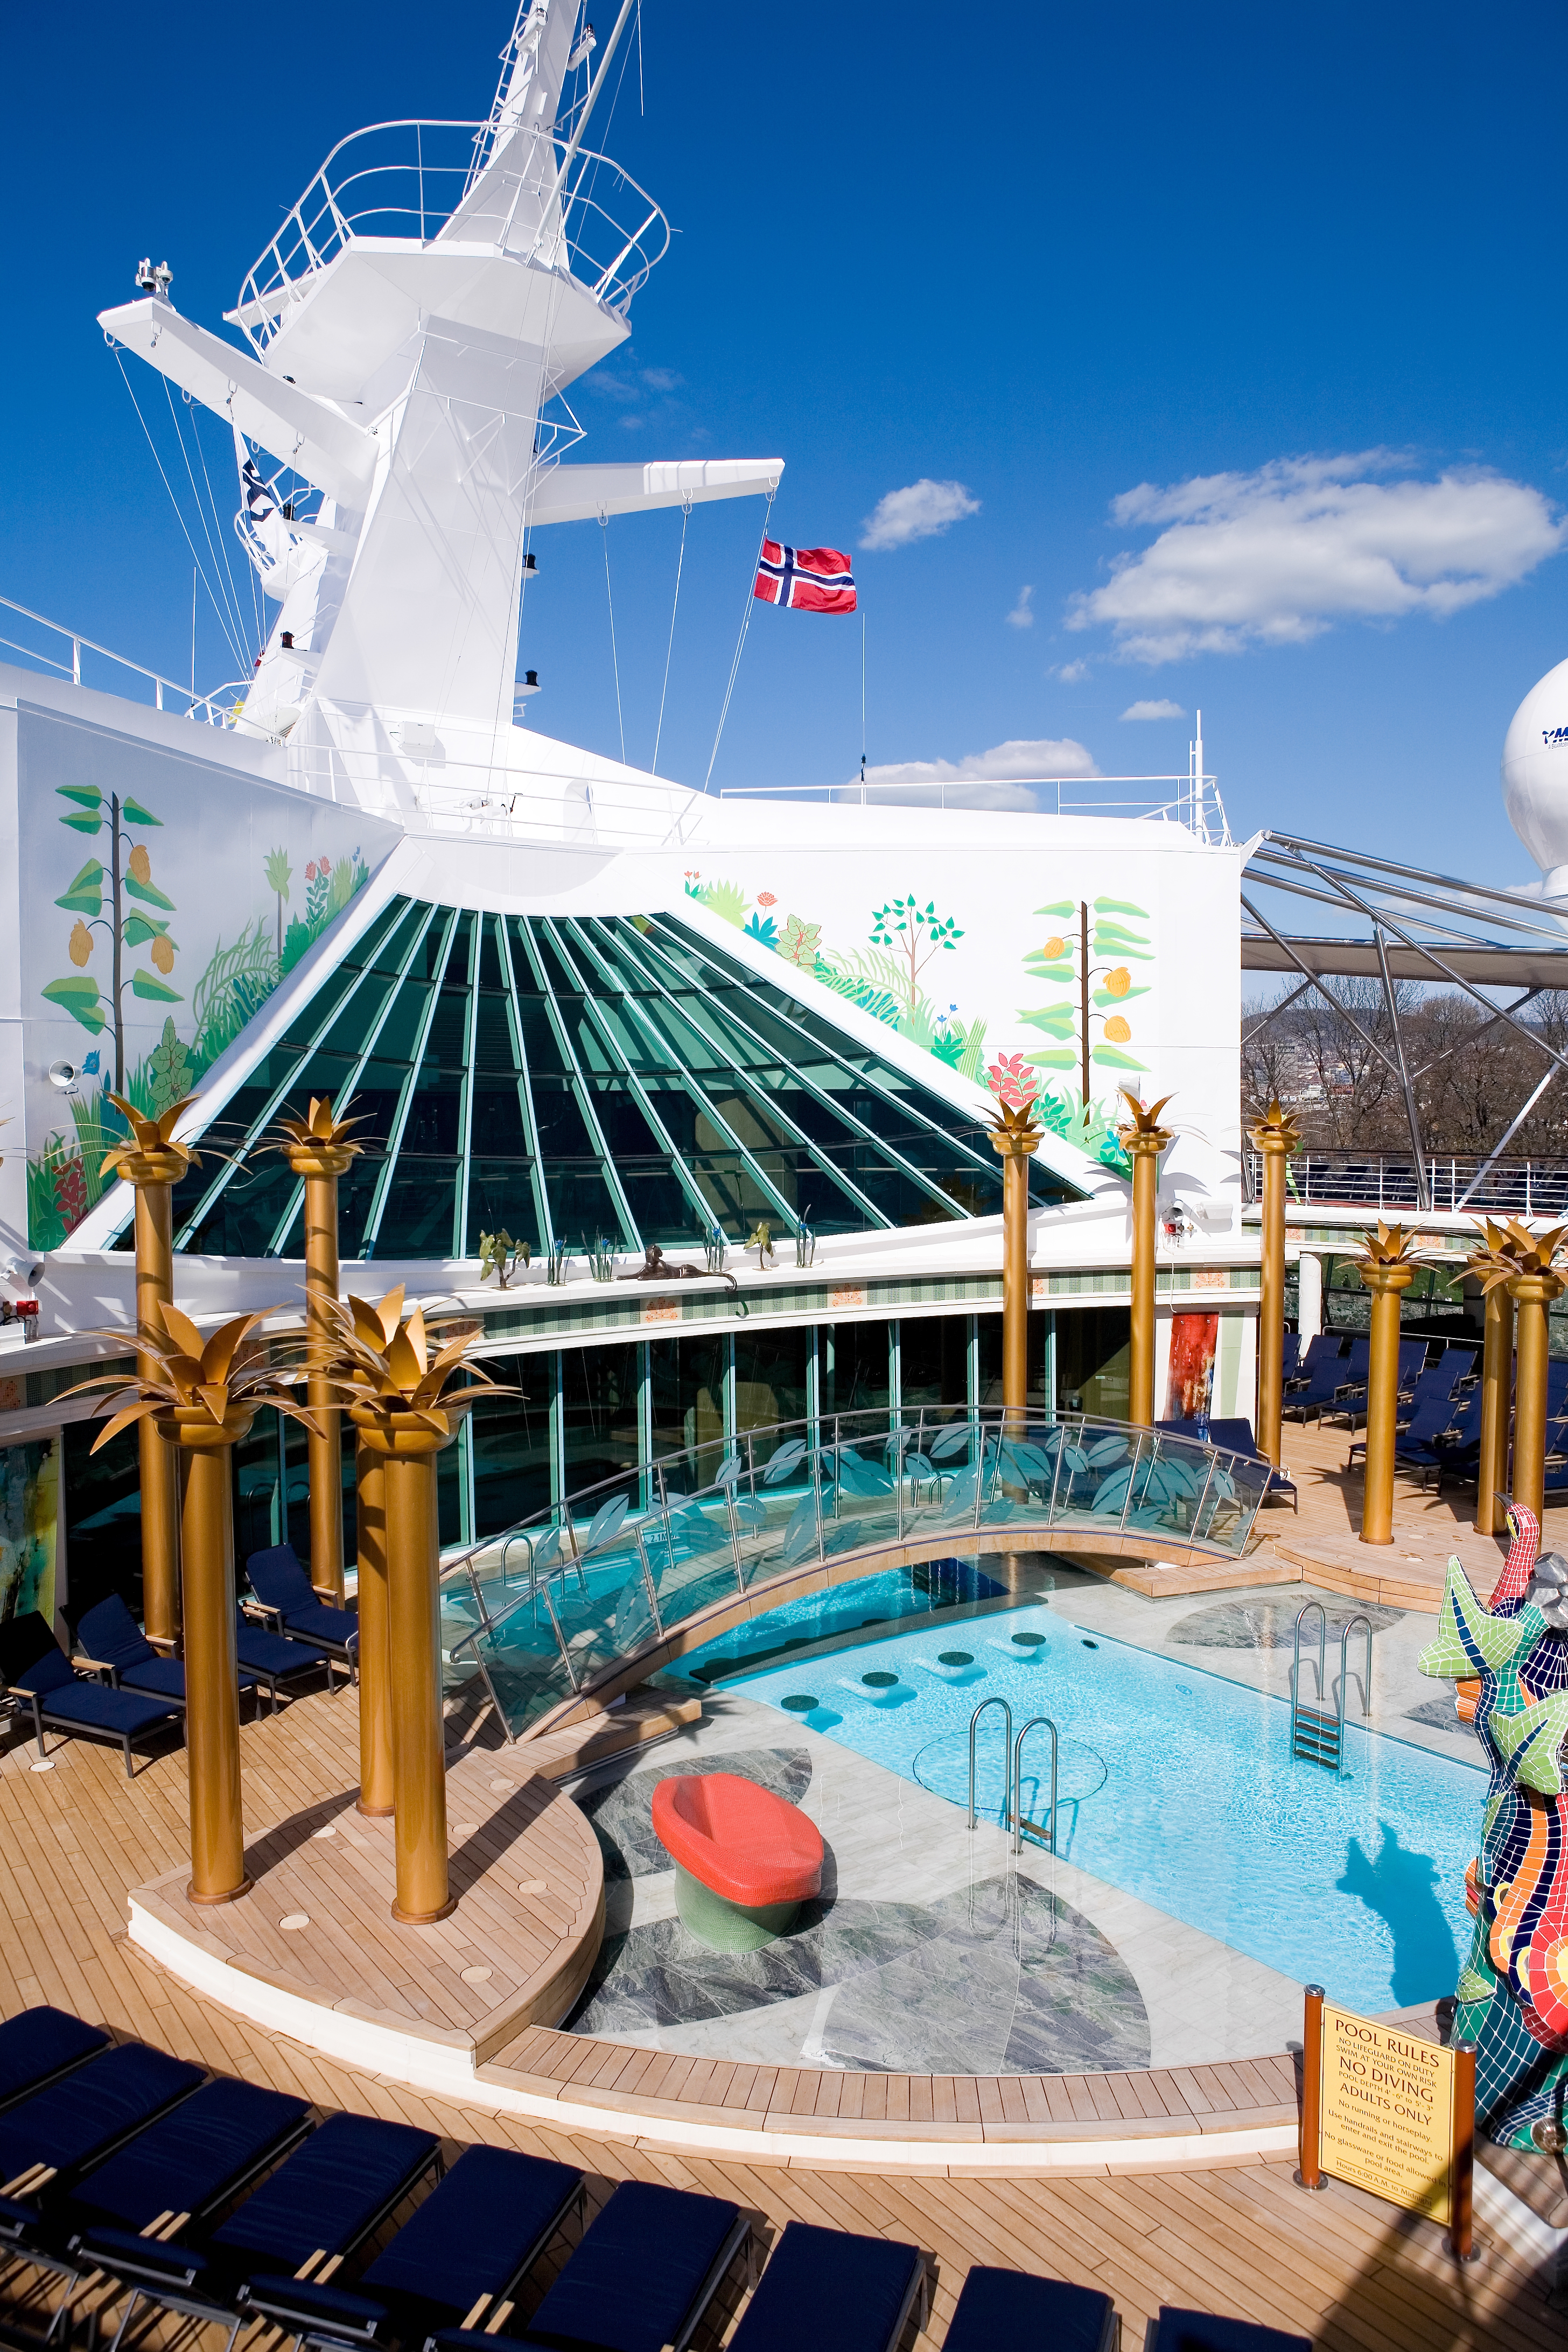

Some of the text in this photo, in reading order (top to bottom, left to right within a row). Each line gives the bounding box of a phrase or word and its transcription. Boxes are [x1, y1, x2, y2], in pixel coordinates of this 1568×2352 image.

[1336, 2019, 1439, 2068] POOL RULES
[1339, 2037, 1434, 2077] NO LIFEGUARD ON DUTY
[1336, 2045, 1437, 2088] SWIM AT YOUR OWN RISK
[1339, 2070, 1358, 2083] POOL
[1360, 2079, 1383, 2092] DEPTH
[1340, 2056, 1433, 2102] NO DIVING
[1339, 2099, 1349, 2109] No
[1352, 2106, 1381, 2123] running
[1393, 2120, 1432, 2143] horseplay.
[1340, 2083, 1432, 2126] ADULTS ONLY
[1328, 2109, 1443, 2161] Use handrails and stairways to
[1341, 2124, 1429, 2165] enter and exit the pool.
[1325, 2131, 1335, 2140] No
[1337, 2137, 1374, 2157] glassware
[1387, 2157, 1404, 2170] food
[1406, 2164, 1437, 2183] allowed
[1439, 2180, 1446, 2188] in
[1365, 2157, 1403, 2178] pool area.
[1336, 2160, 1356, 2173] Hours
[1357, 2169, 1373, 2181] 6:00
[1374, 2176, 1390, 2188] A.M.
[1401, 2188, 1432, 2207] Midnight
